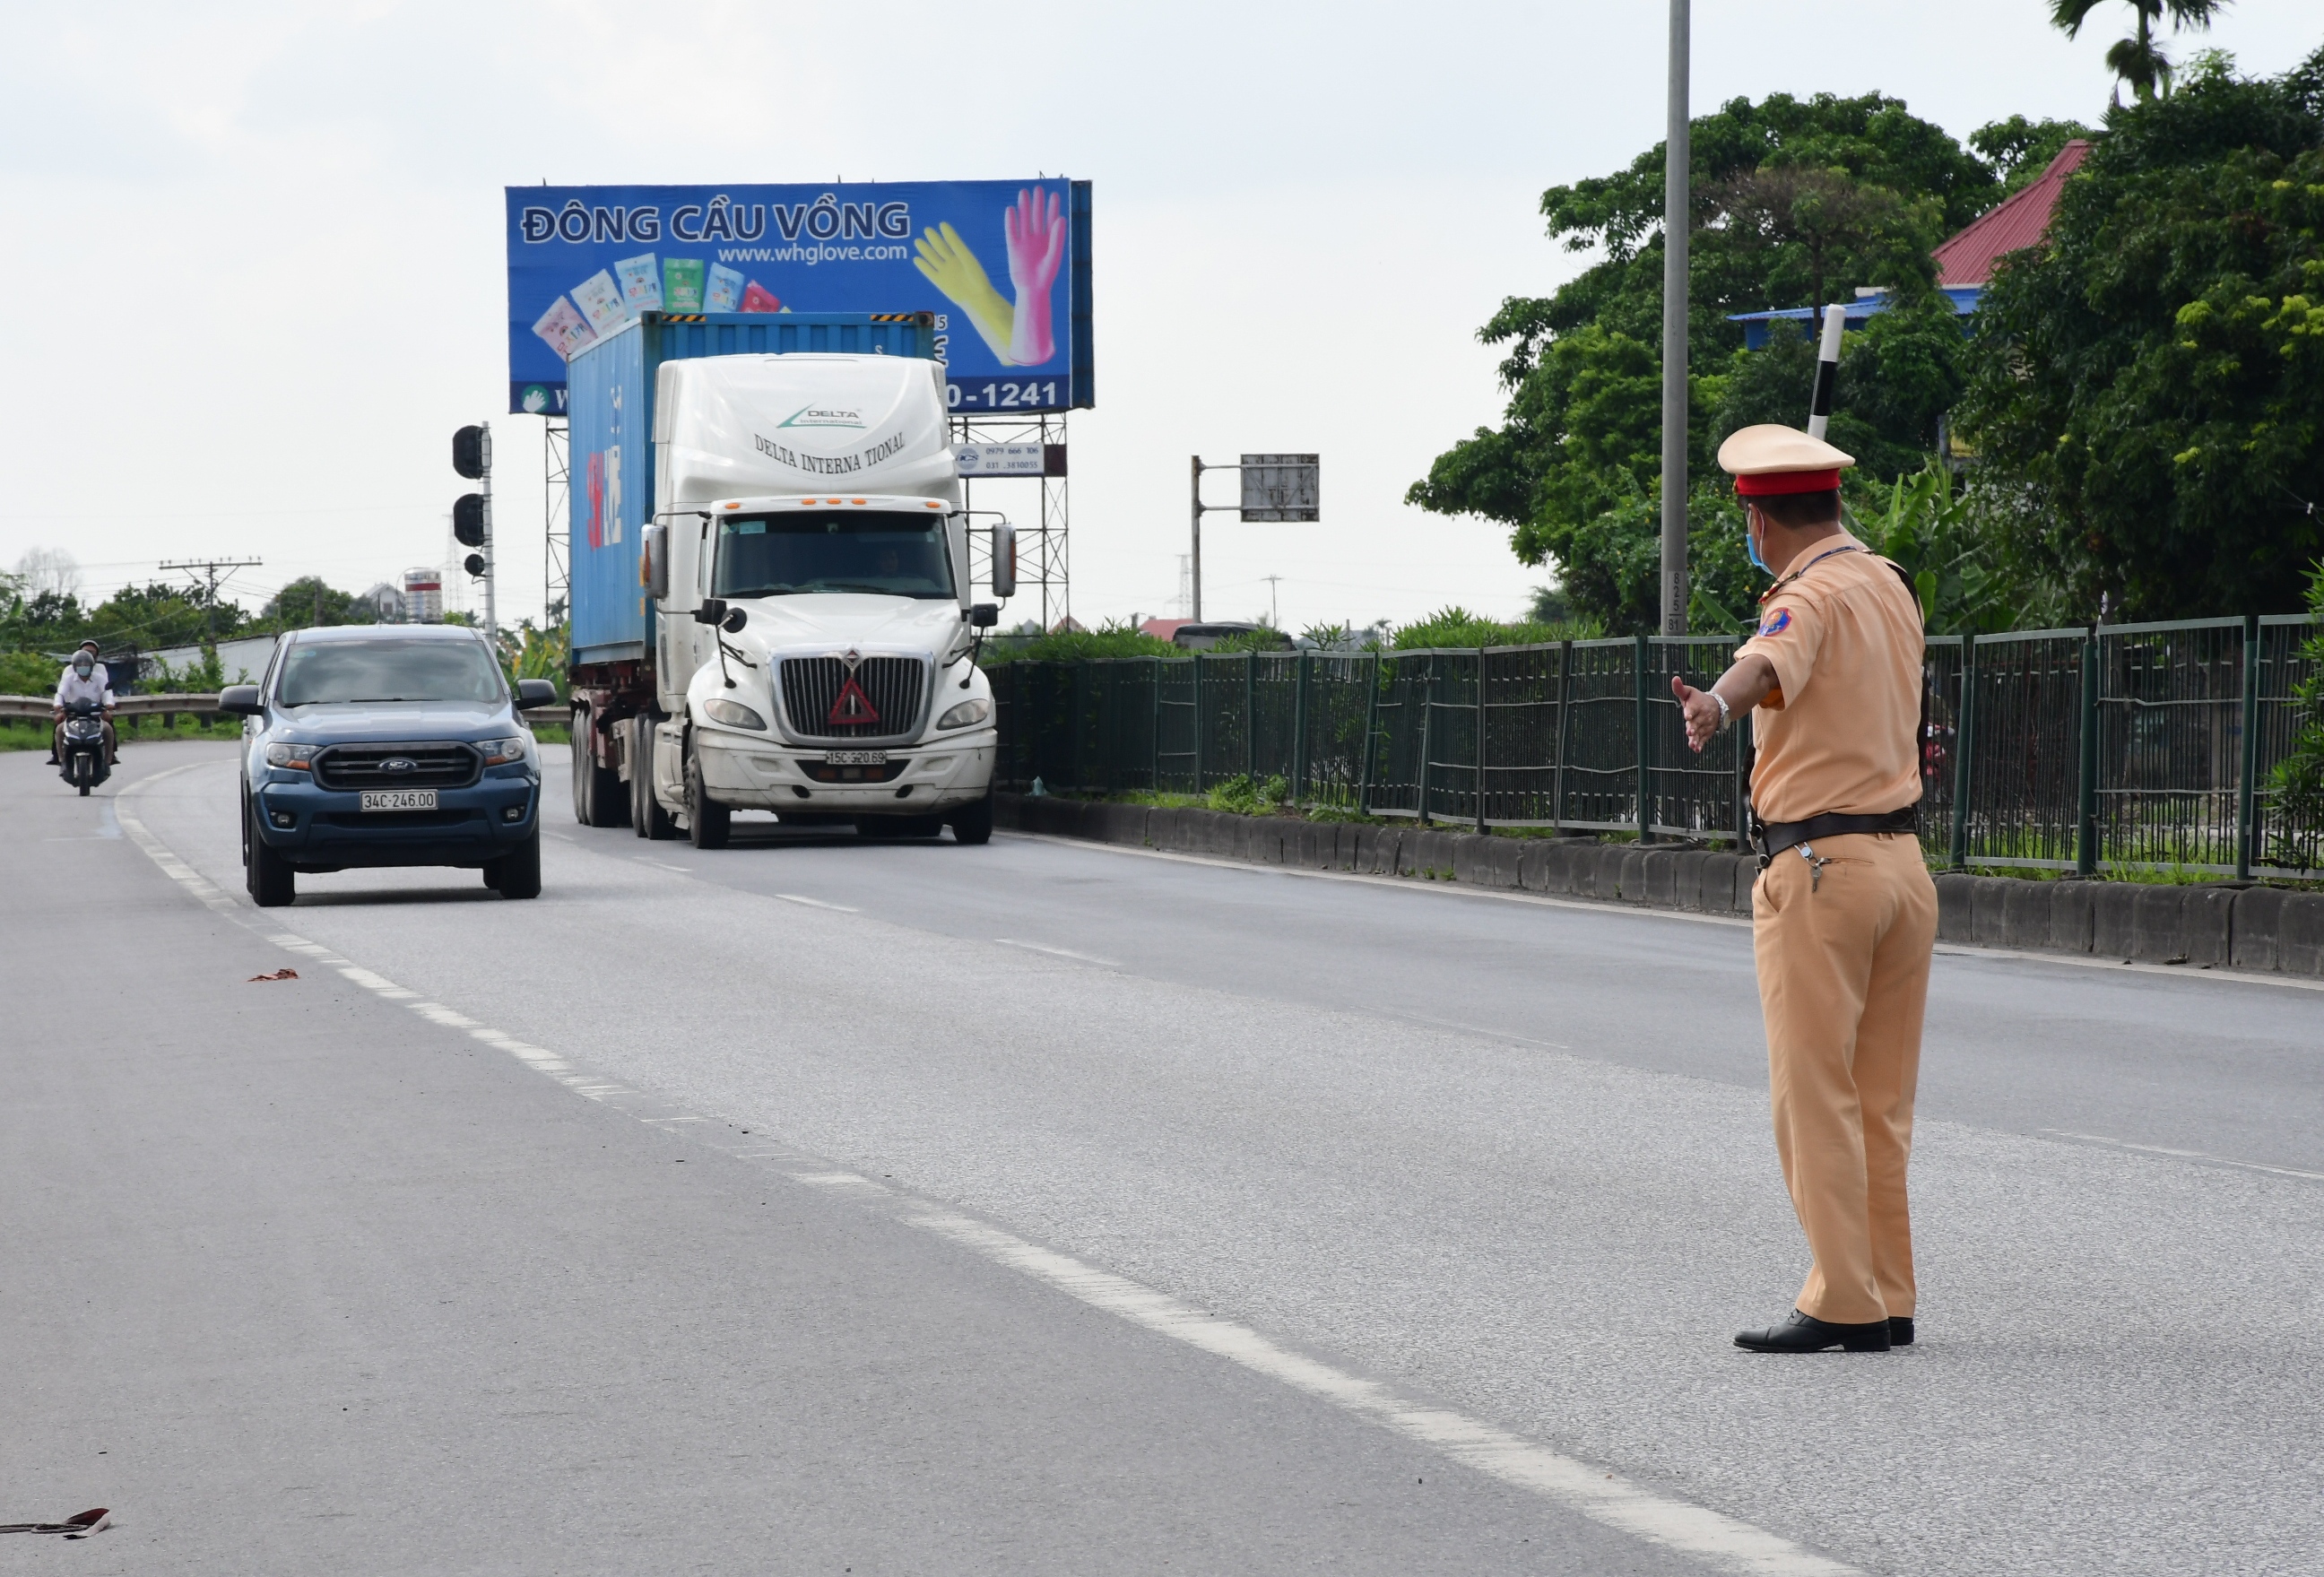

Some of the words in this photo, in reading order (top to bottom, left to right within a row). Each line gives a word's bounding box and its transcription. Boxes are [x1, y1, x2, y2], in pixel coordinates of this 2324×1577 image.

[521, 199, 660, 243] ĐÔNG
[671, 195, 765, 242] CẦU
[773, 194, 910, 239] VỒNG
[718, 242, 907, 265] www.whglove.com
[808, 410, 859, 419] DELTA
[754, 433, 797, 467] DELTA
[364, 793, 434, 808] 34C-246.00
